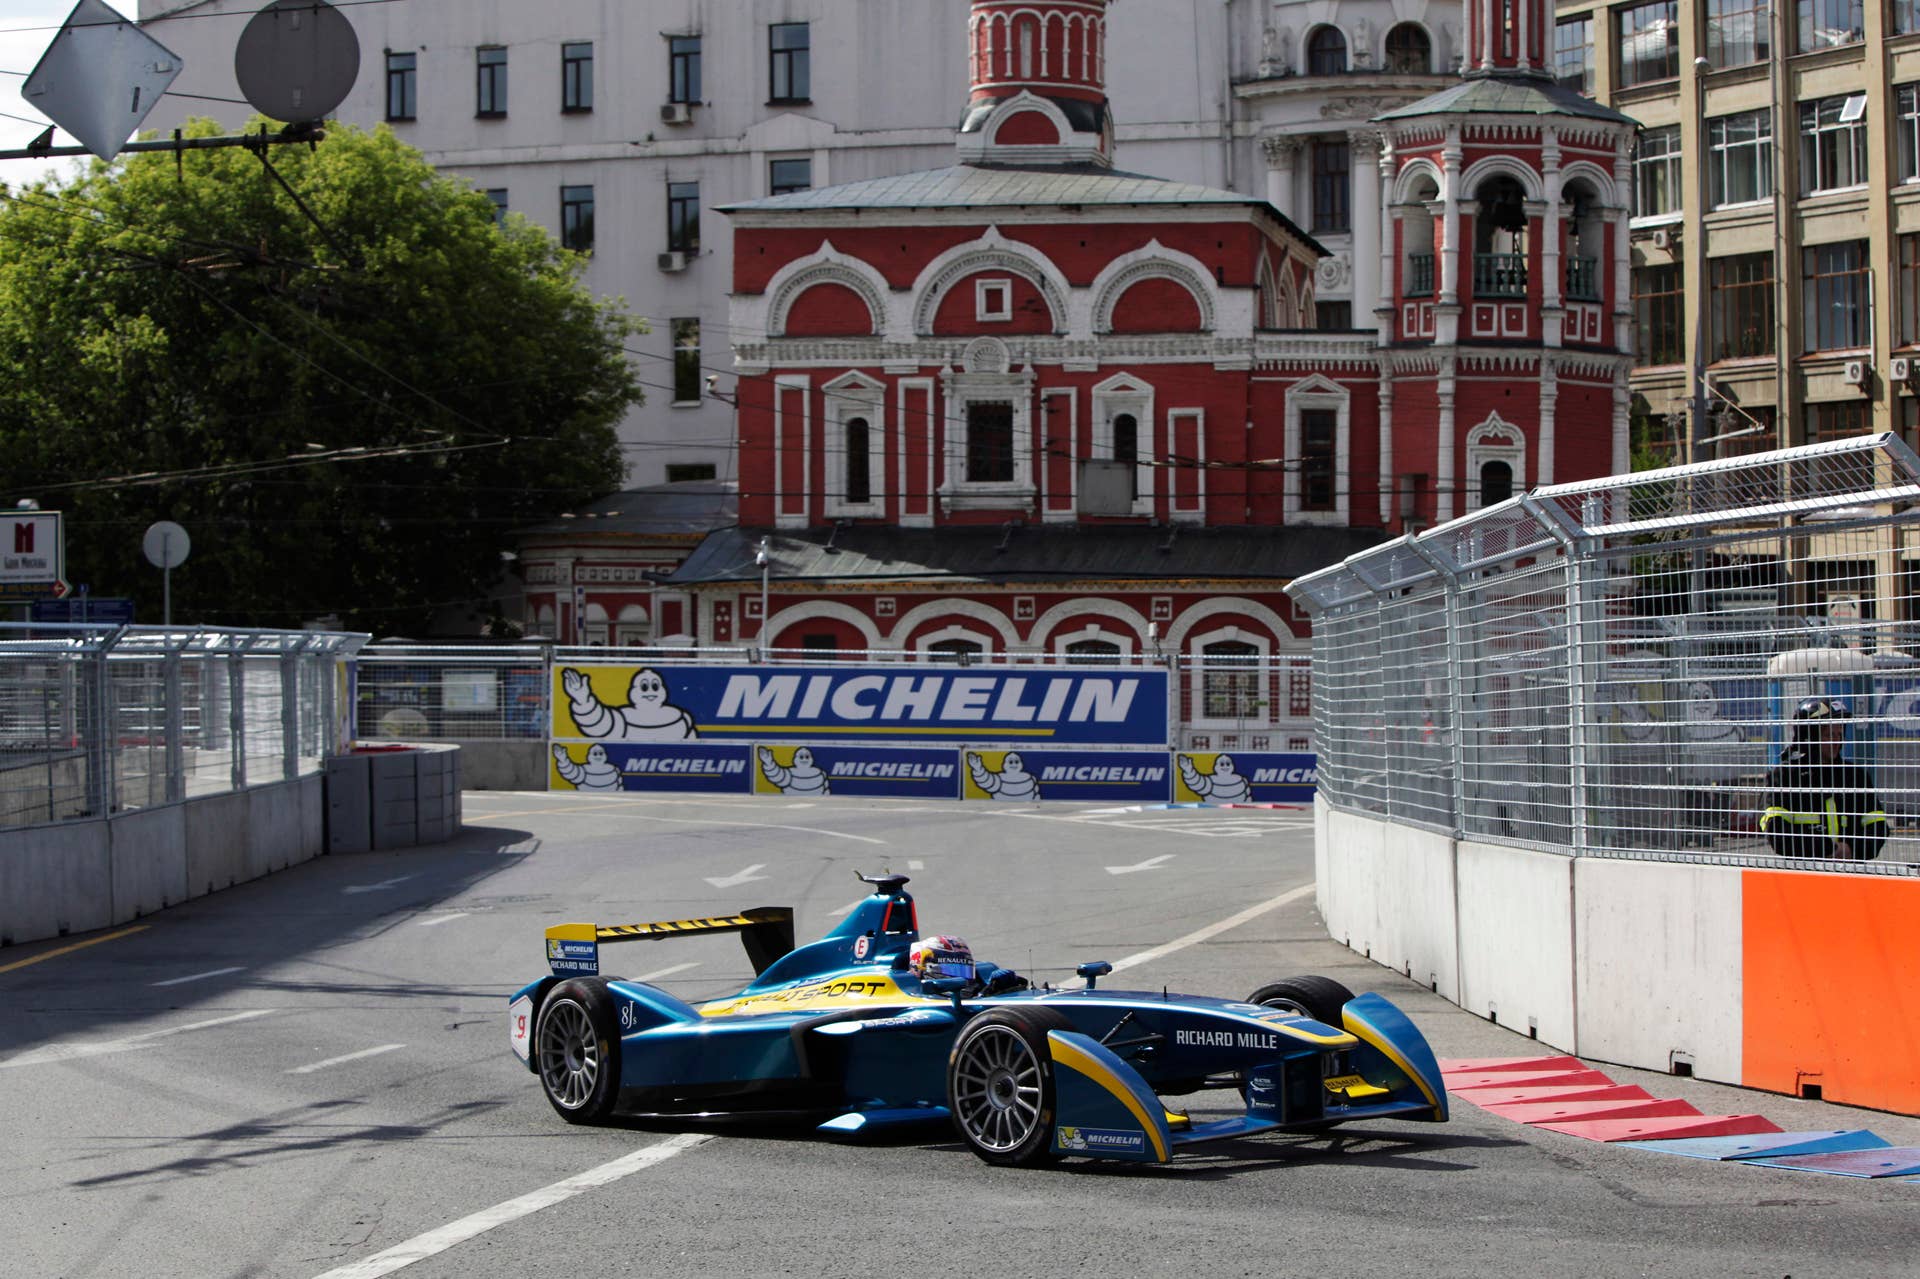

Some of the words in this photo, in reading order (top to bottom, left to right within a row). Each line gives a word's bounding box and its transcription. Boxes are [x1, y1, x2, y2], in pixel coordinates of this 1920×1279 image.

[716, 674, 1140, 723] MICHELIN
[624, 757, 746, 775] MICHELIN
[831, 761, 955, 779] MICHELIN
[1041, 765, 1166, 782] MICHELIN
[1252, 768, 1318, 783] MICH
[564, 945, 594, 953] MICHELIN
[857, 939, 865, 955] E
[550, 960, 578, 970] RICHARD
[579, 962, 598, 971] MILLE
[1176, 1030, 1234, 1047] RICHARD
[1237, 1032, 1278, 1049] MILLE
[1087, 1134, 1142, 1145] MICHELIN
